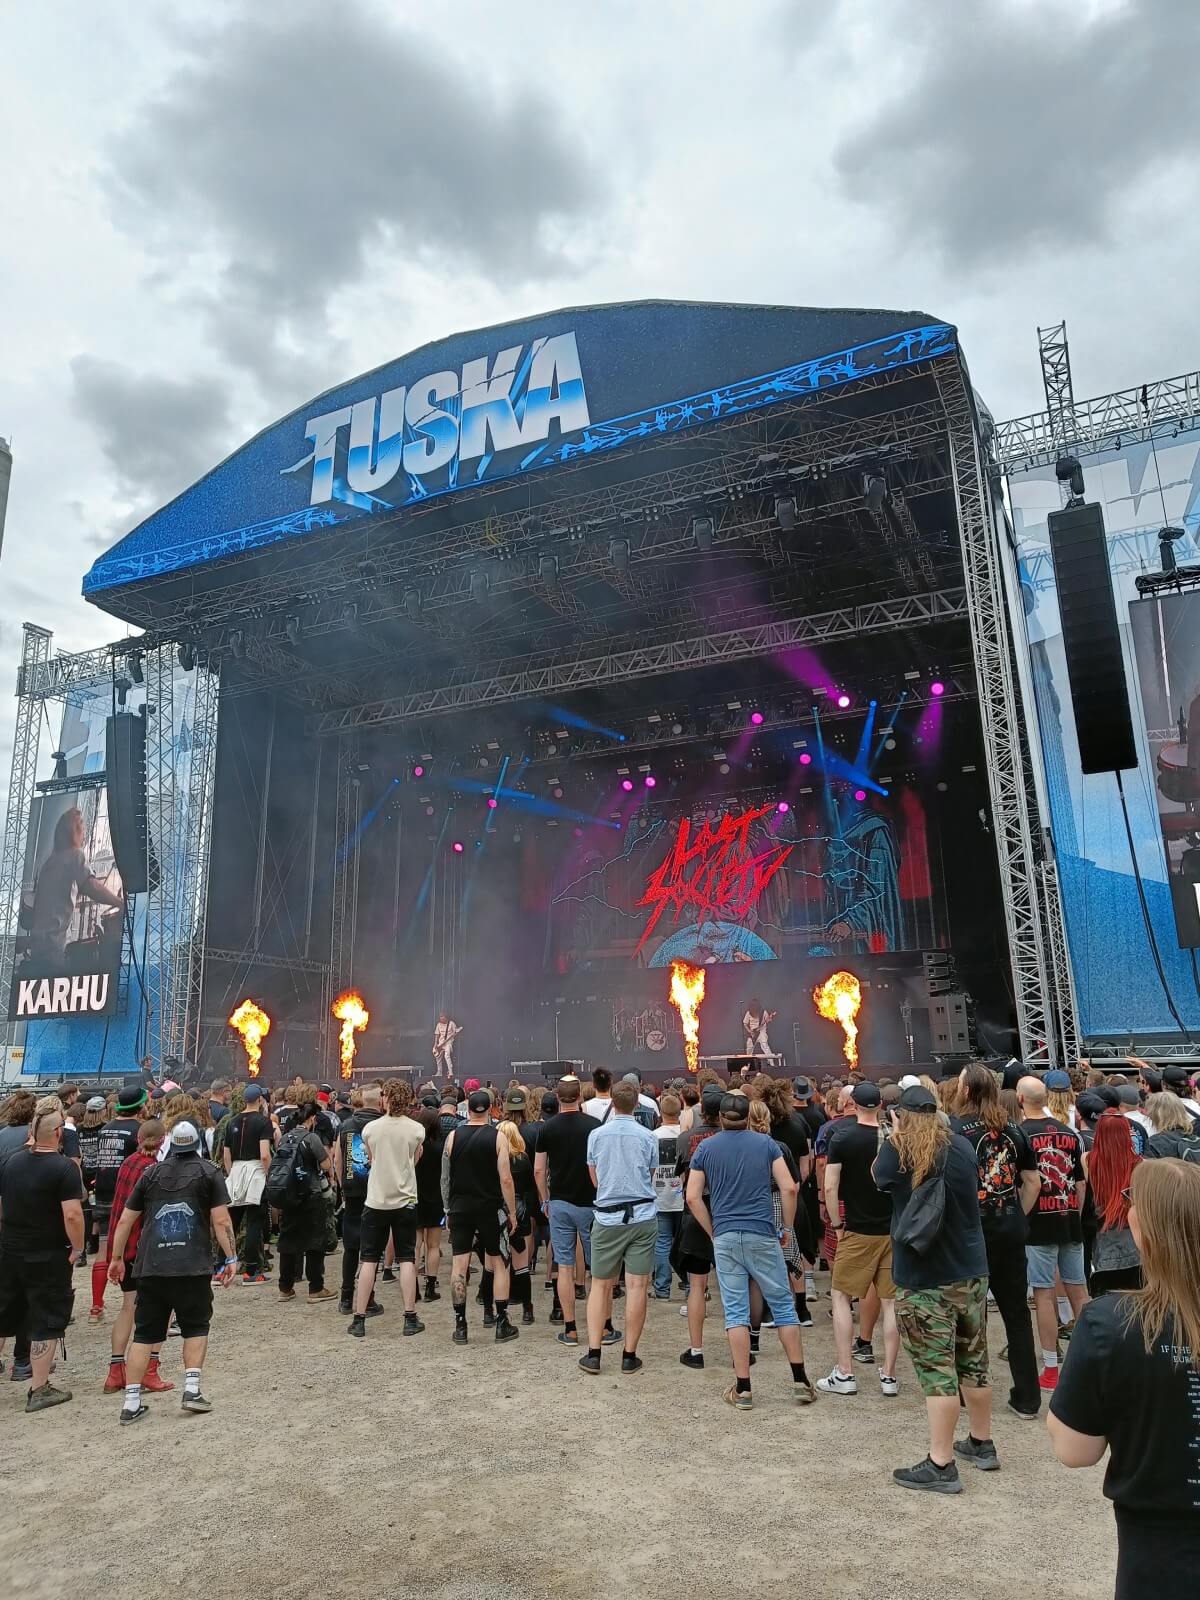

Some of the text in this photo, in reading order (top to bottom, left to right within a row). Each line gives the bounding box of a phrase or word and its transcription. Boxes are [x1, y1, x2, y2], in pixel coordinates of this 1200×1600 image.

[302, 331, 590, 506] TUSKA
[16, 974, 109, 1015] KARHU
[1160, 1344, 1191, 1354] IF THE
